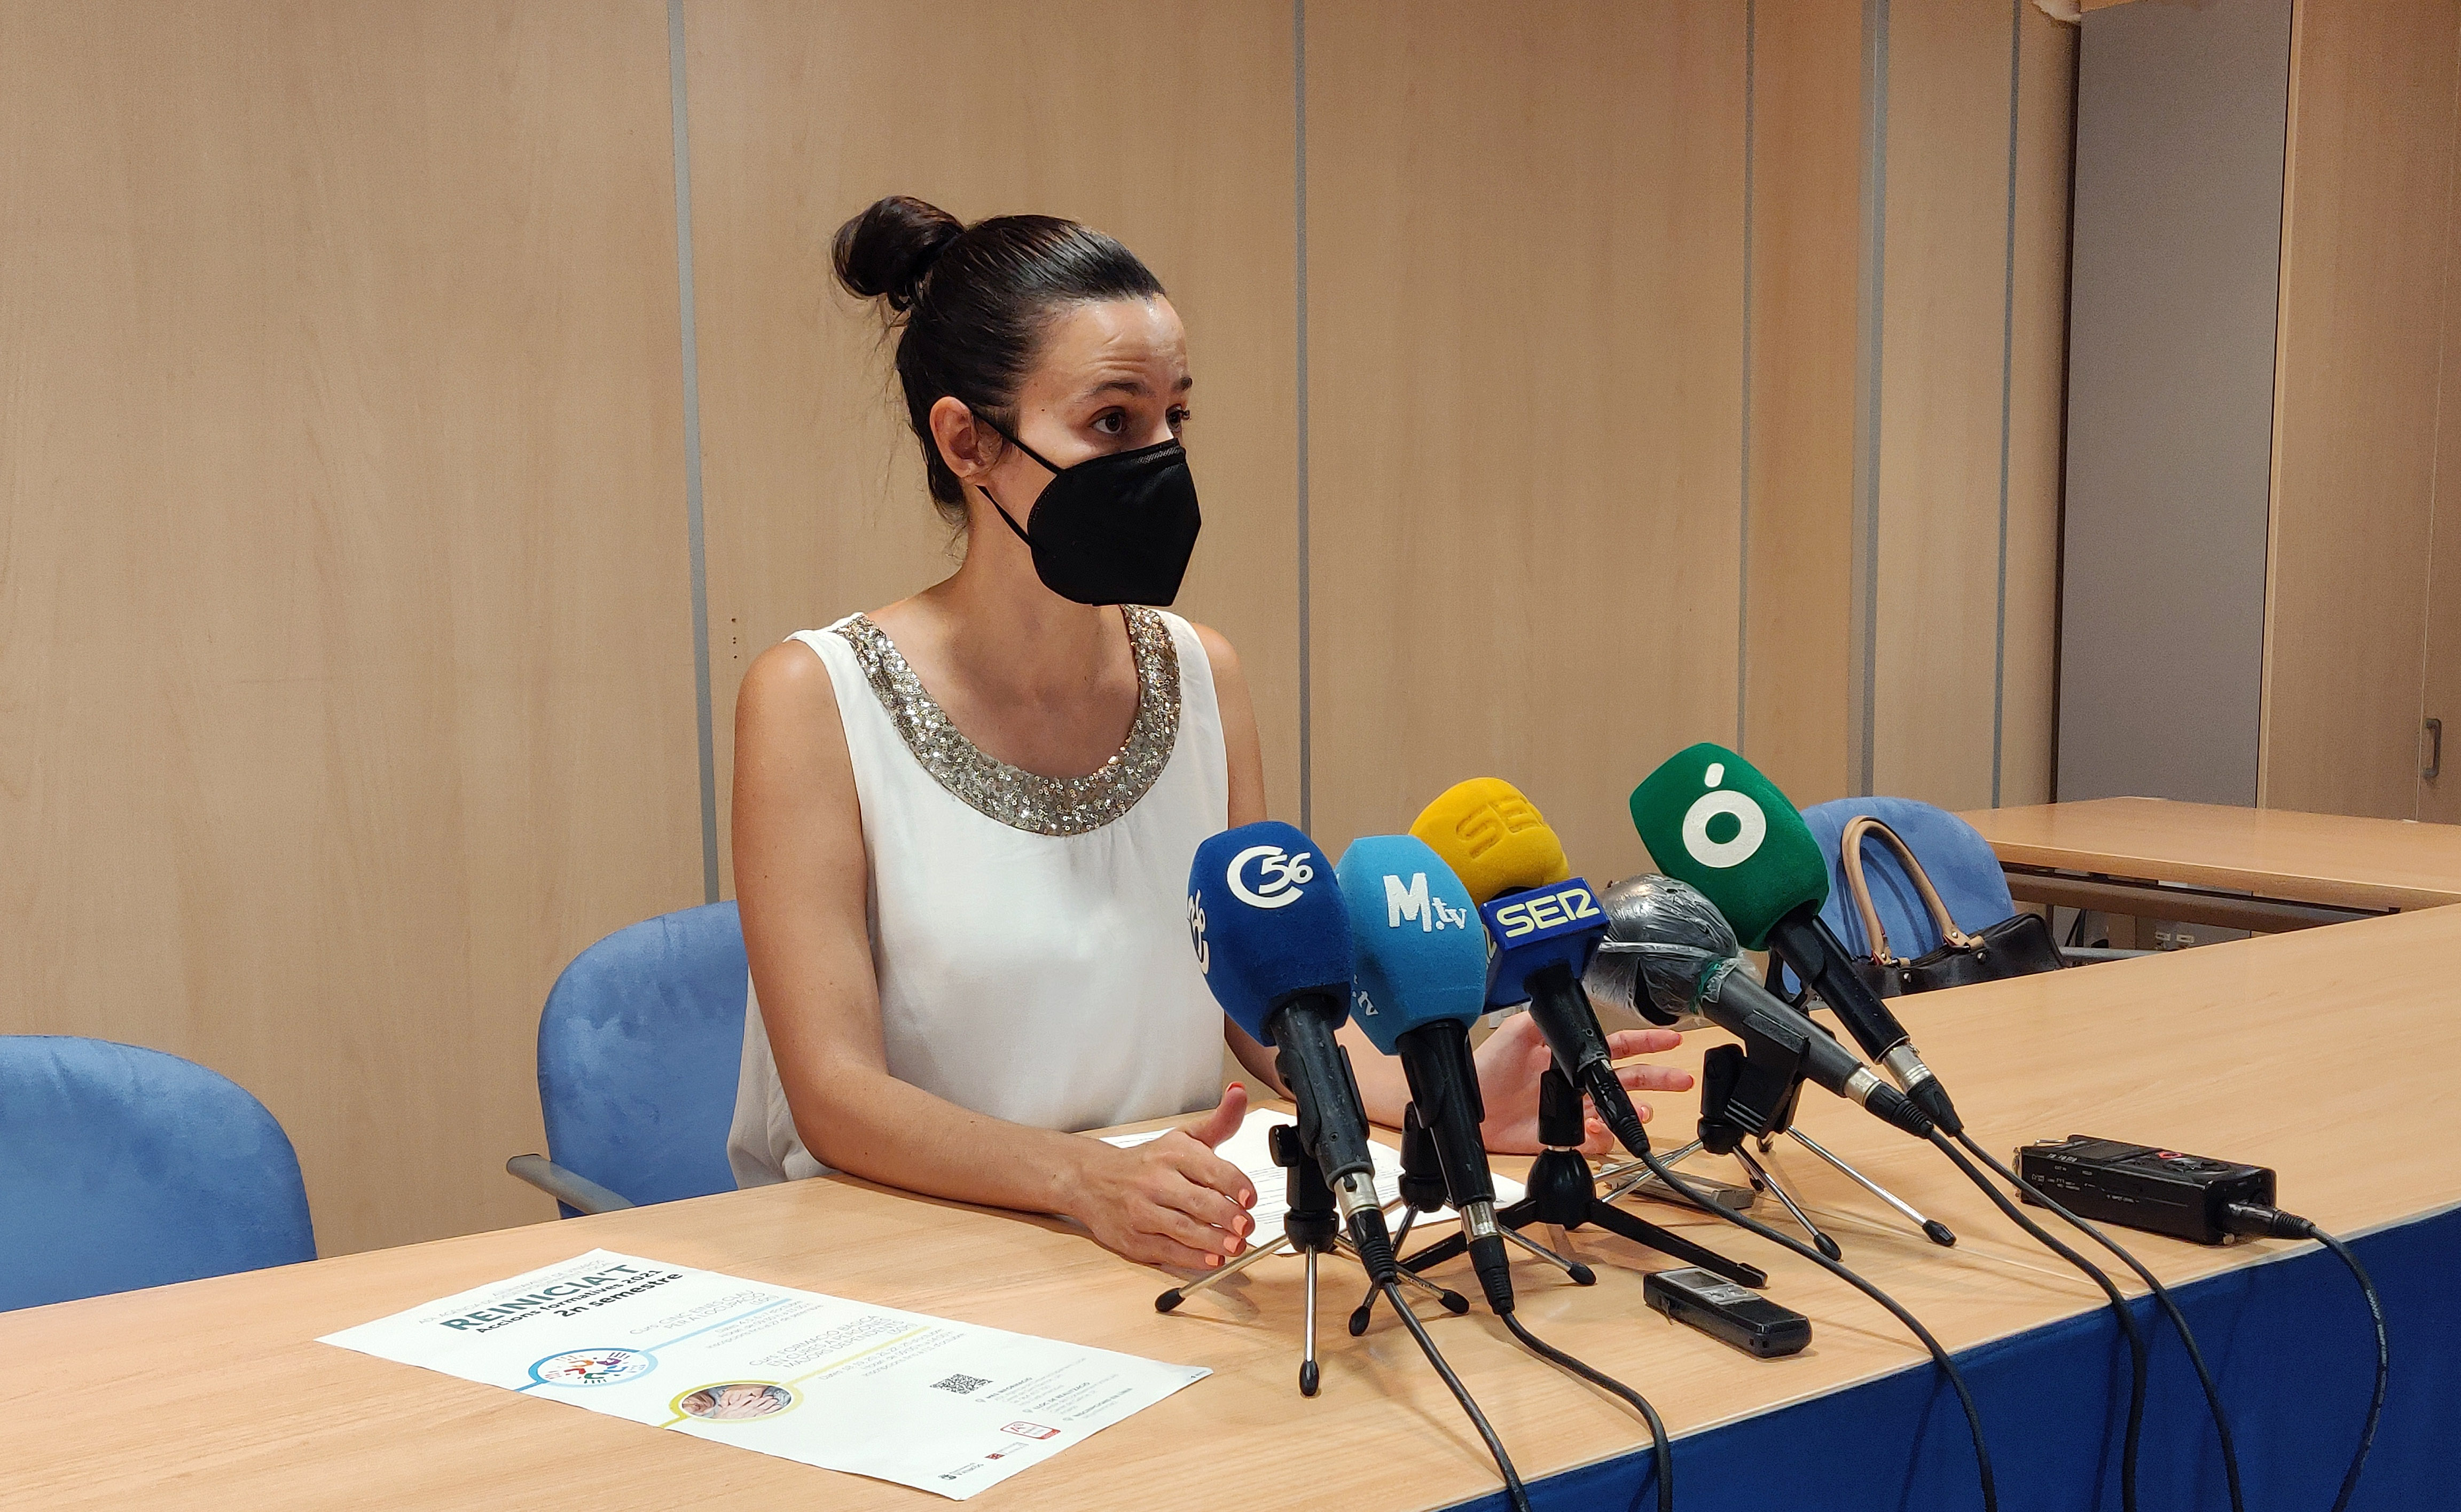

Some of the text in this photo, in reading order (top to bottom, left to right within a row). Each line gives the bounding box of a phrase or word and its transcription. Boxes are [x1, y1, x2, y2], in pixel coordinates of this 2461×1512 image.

[1227, 845, 1314, 908] C56
[1496, 888, 1601, 938] SER
[440, 1264, 639, 1330] REINICIA'T
[476, 1269, 664, 1333] Accions formatives 2021
[553, 1272, 683, 1318] 2n semestre
